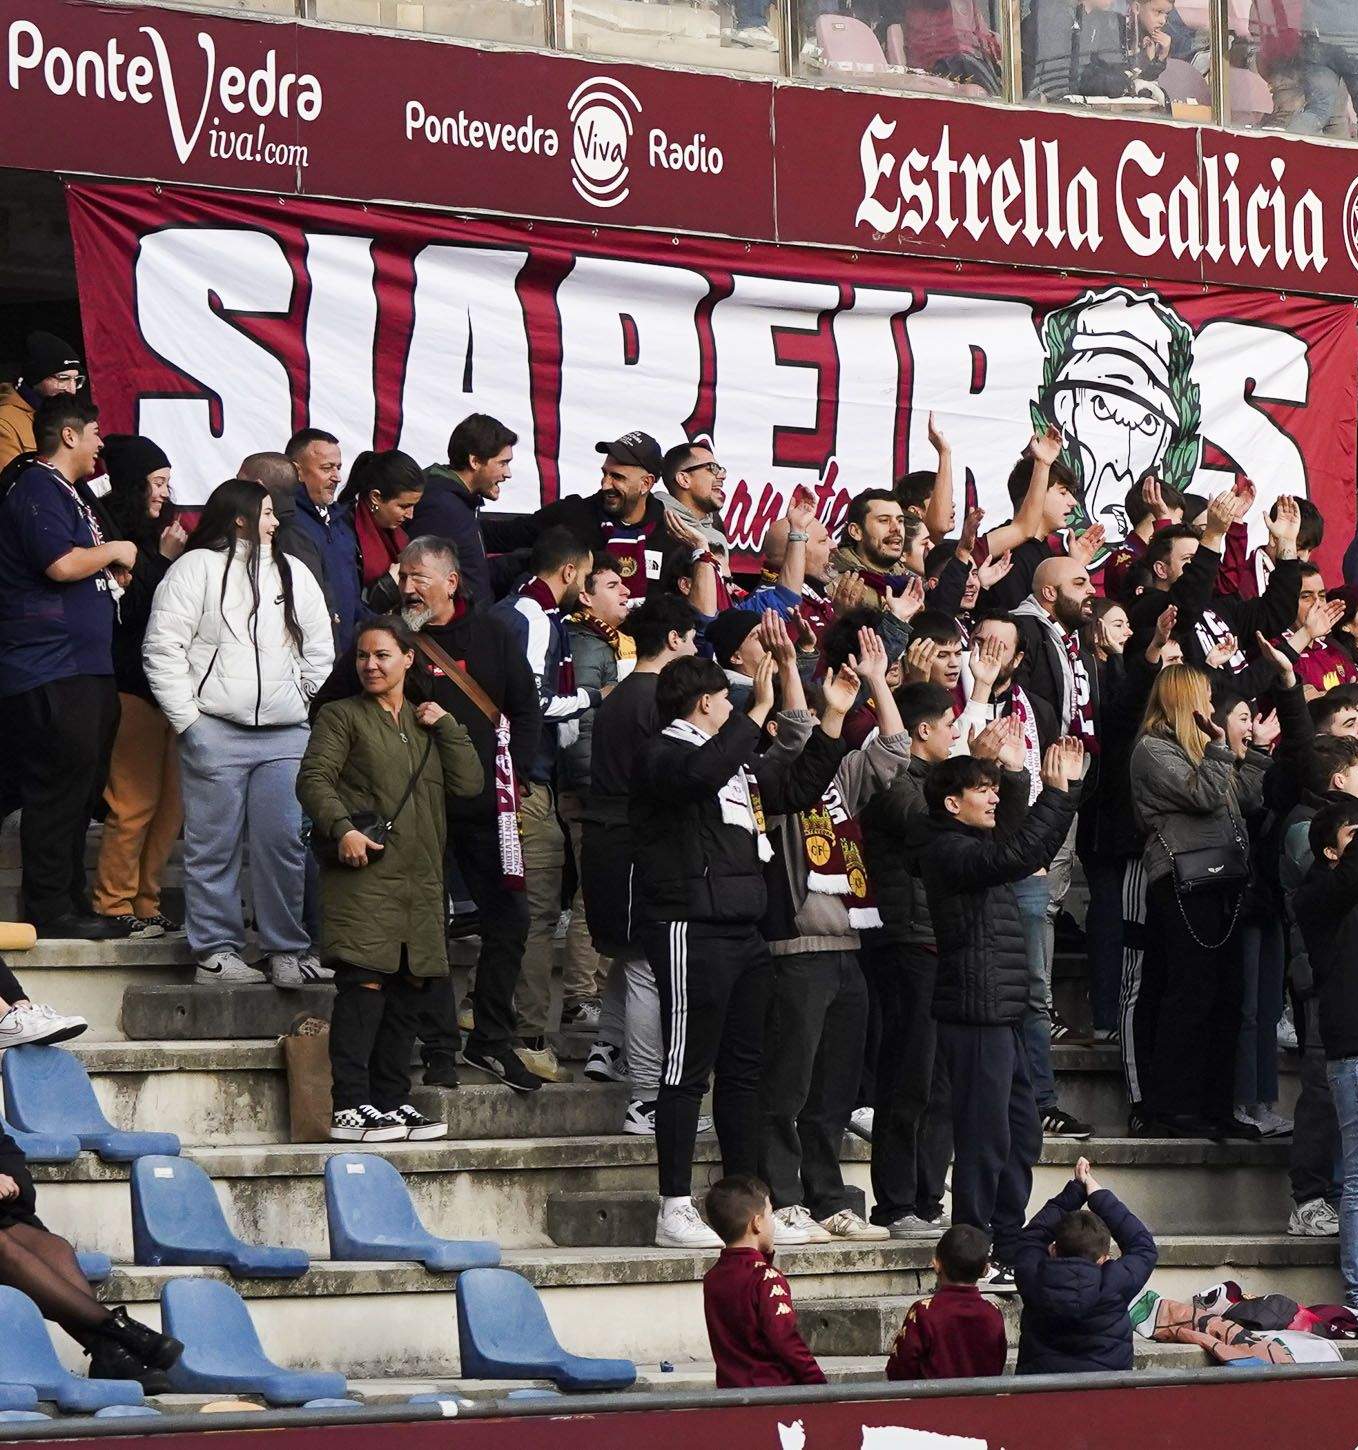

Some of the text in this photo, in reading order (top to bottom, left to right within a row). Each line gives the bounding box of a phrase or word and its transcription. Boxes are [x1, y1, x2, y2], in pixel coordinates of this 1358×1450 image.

[406, 101, 559, 157] Pontevedra
[577, 120, 625, 164] Viva
[649, 129, 724, 175] Radio
[856, 114, 1330, 274] Estrella Galicia
[134, 225, 1310, 558] SIAREIRS
[504, 815, 513, 875] PONTEVEDRA
